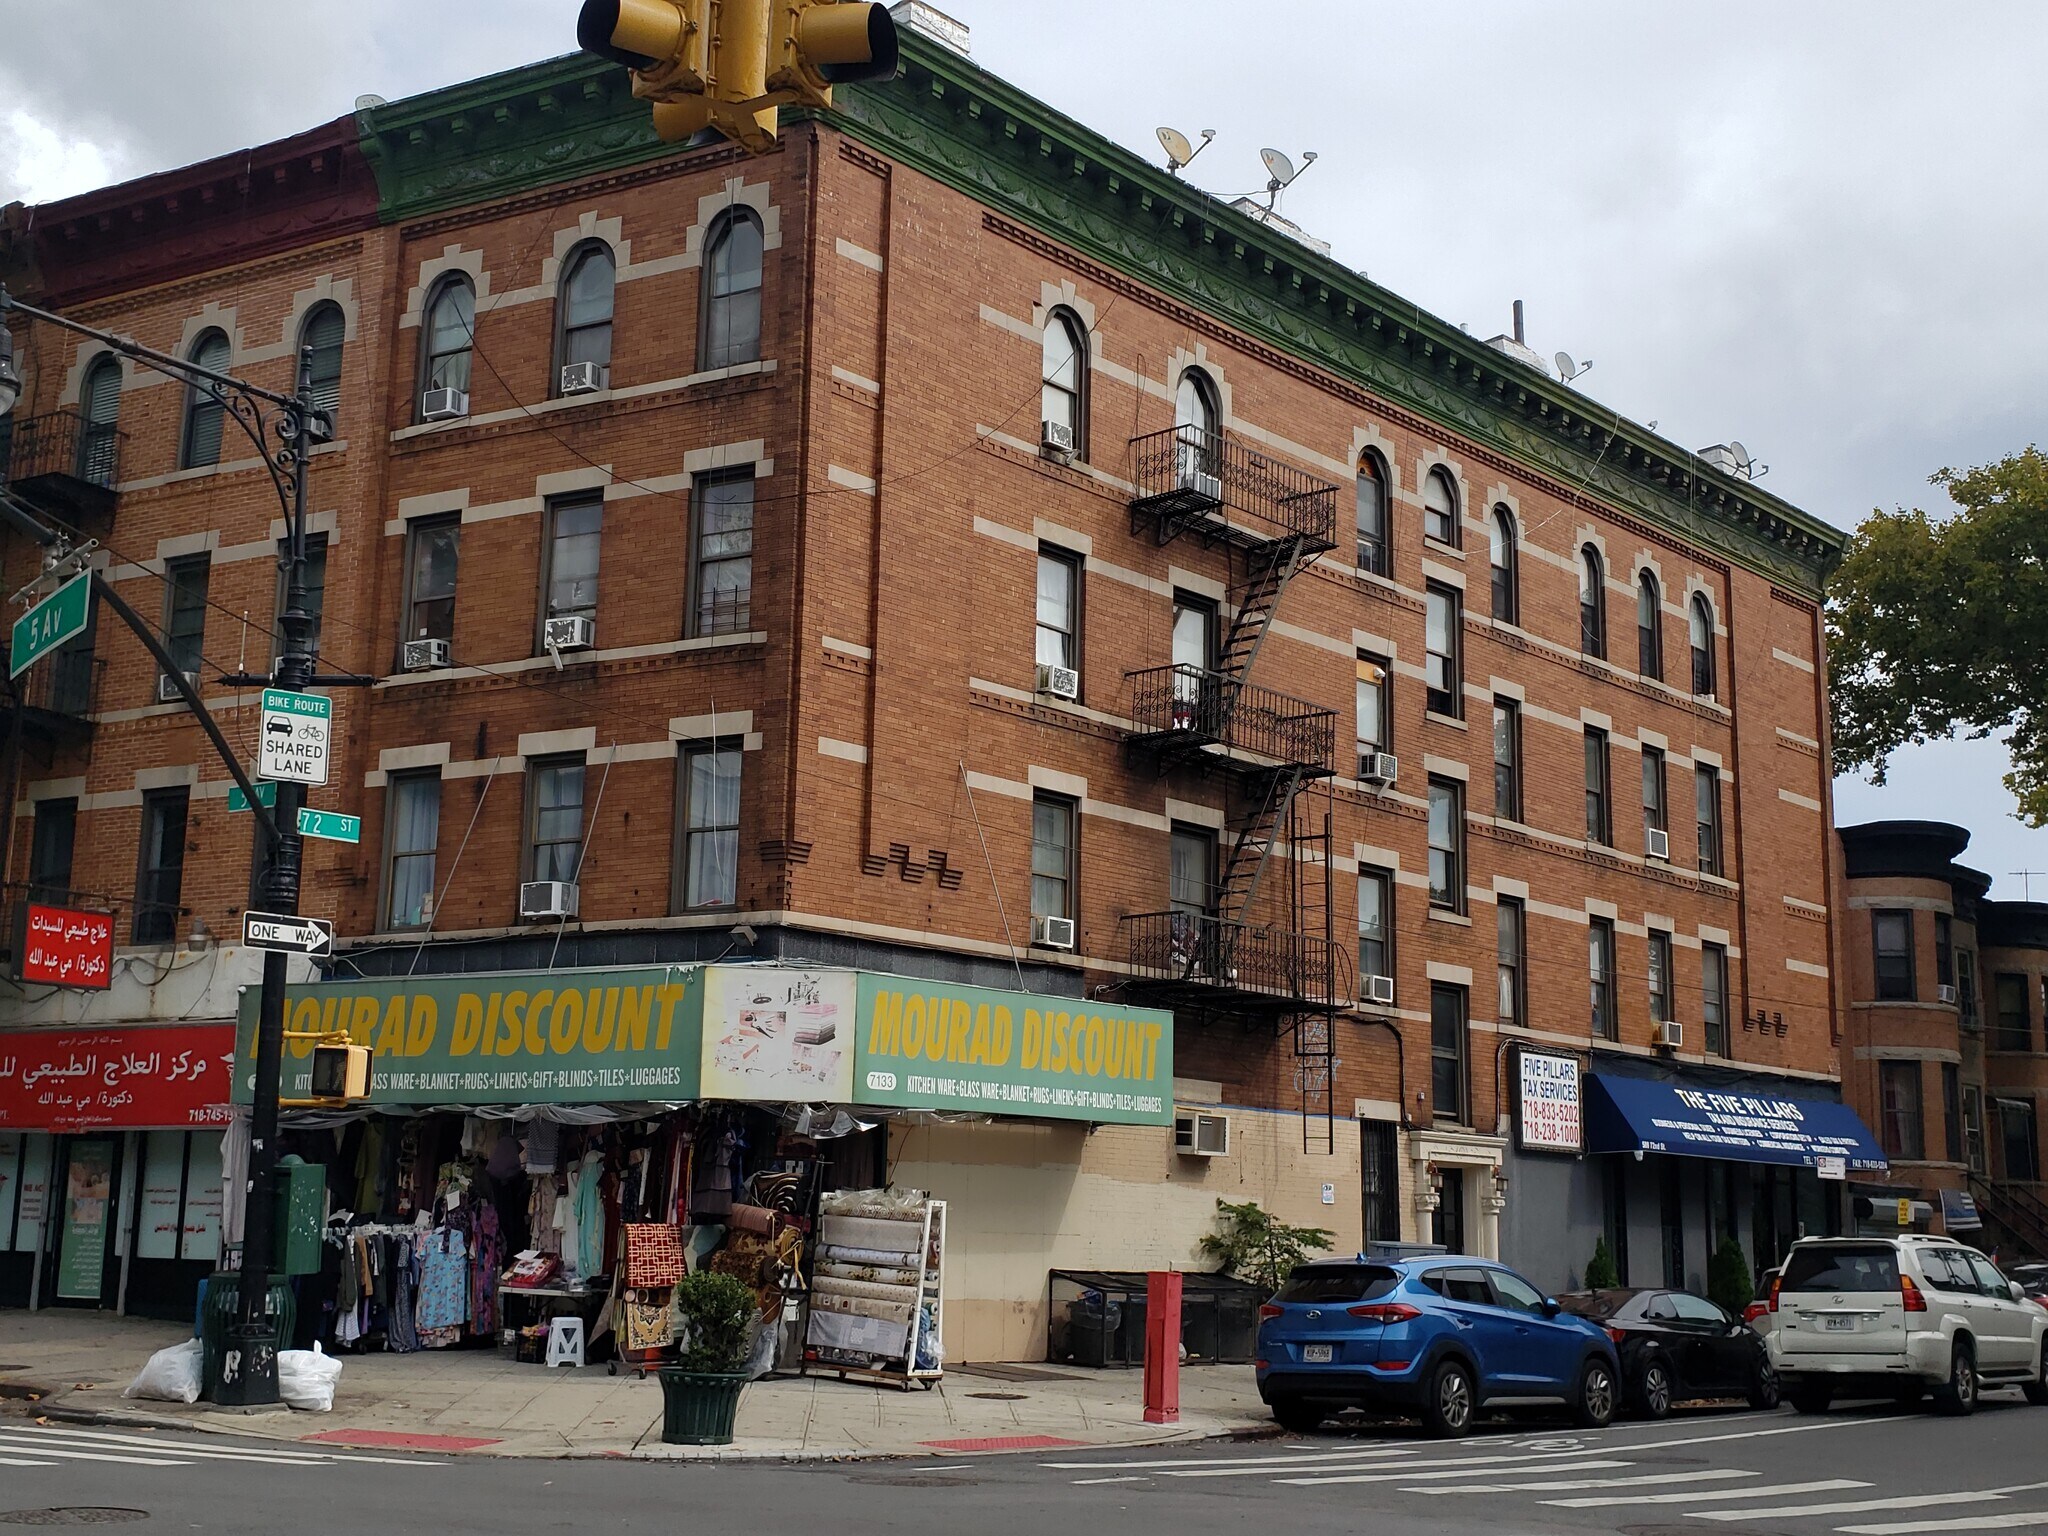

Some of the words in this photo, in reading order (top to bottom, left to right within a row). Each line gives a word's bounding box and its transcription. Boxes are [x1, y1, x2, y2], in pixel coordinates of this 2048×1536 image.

[30, 617, 39, 650] 5
[268, 695, 290, 708] BIKE
[294, 699, 326, 713] ROUTE
[265, 739, 323, 759] SHARED
[274, 758, 312, 775] LANE
[302, 812, 322, 833] 72
[340, 819, 353, 833] ST
[32, 915, 64, 936] للسيدات
[64, 920, 89, 942] طبيعي
[90, 923, 107, 944] علاج
[252, 924, 280, 939] ONE
[295, 928, 321, 944] WAY
[29, 947, 43, 965] الله
[44, 953, 58, 972] عبد
[60, 959, 72, 978] مي
[450, 984, 685, 1057] DISCOUNT
[868, 990, 1013, 1066] MOURAD
[1020, 1008, 1162, 1081] DISCOUNT
[22, 1054, 97, 1089] الطبيعي
[104, 1052, 160, 1086] العلاج
[165, 1050, 207, 1081] مركز
[1524, 1058, 1541, 1077] FIVE
[1543, 1061, 1575, 1081] PILLARS
[391, 1073, 415, 1090] WARE
[420, 1073, 460, 1090] BLANKET
[464, 1072, 489, 1090] RUGS
[494, 1071, 528, 1090] LINENS
[533, 1070, 554, 1088] GIFT
[559, 1069, 594, 1088] BLINDS
[599, 1068, 625, 1087] TILES
[630, 1067, 681, 1086] LUGGAGES
[869, 1074, 893, 1088] 7133
[38, 1091, 54, 1105] الله
[56, 1093, 73, 1109] عبد
[907, 1075, 936, 1094] KITCHEN
[937, 1078, 956, 1096] WARE
[959, 1080, 980, 1098] GLASS
[981, 1082, 999, 1100] WARE
[1002, 1084, 1031, 1103] BLANKET
[1033, 1087, 1050, 1104] RUGS
[1052, 1088, 1075, 1106] LINENS
[1077, 1090, 1090, 1107] GIFT
[1092, 1092, 1114, 1109] BLINDS
[1116, 1094, 1131, 1111] TILES
[1134, 1096, 1162, 1113] LUGGAGES
[1523, 1079, 1539, 1098] TAX
[1540, 1081, 1578, 1102] SERVICES
[76, 1096, 91, 1111] مي
[1523, 1100, 1578, 1123] 718-833-5202
[1673, 1088, 1713, 1111] THE
[1707, 1093, 1747, 1115] FIVE
[1741, 1097, 1805, 1121] PILLARS
[1524, 1121, 1579, 1143] 718-238-1000
